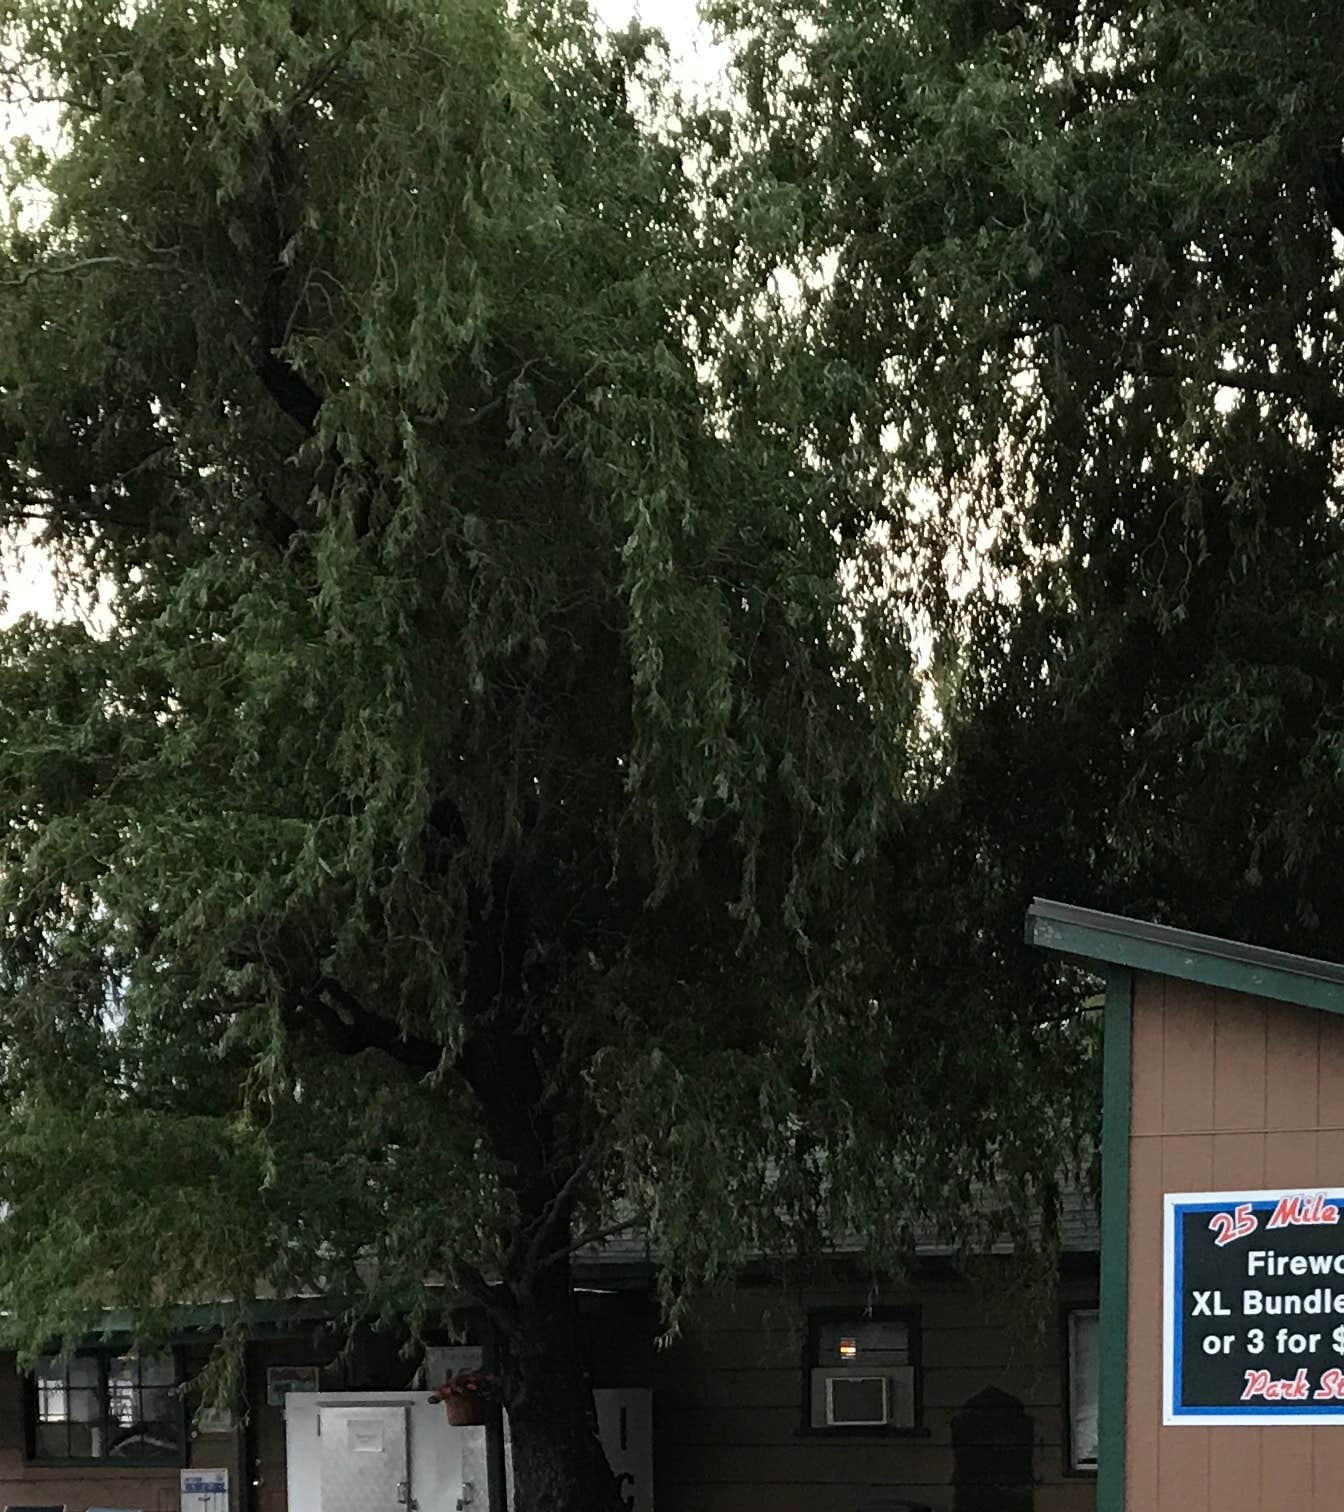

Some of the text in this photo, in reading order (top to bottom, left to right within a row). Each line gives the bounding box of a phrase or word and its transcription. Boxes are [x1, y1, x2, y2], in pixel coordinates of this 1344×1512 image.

[1209, 1203, 1258, 1246] 25
[1266, 1193, 1341, 1229] Mile
[1191, 1290, 1232, 1316] XL
[1202, 1333, 1235, 1355] or
[1246, 1328, 1266, 1354] 3
[1275, 1328, 1322, 1354] for
[1239, 1368, 1309, 1401] Park
